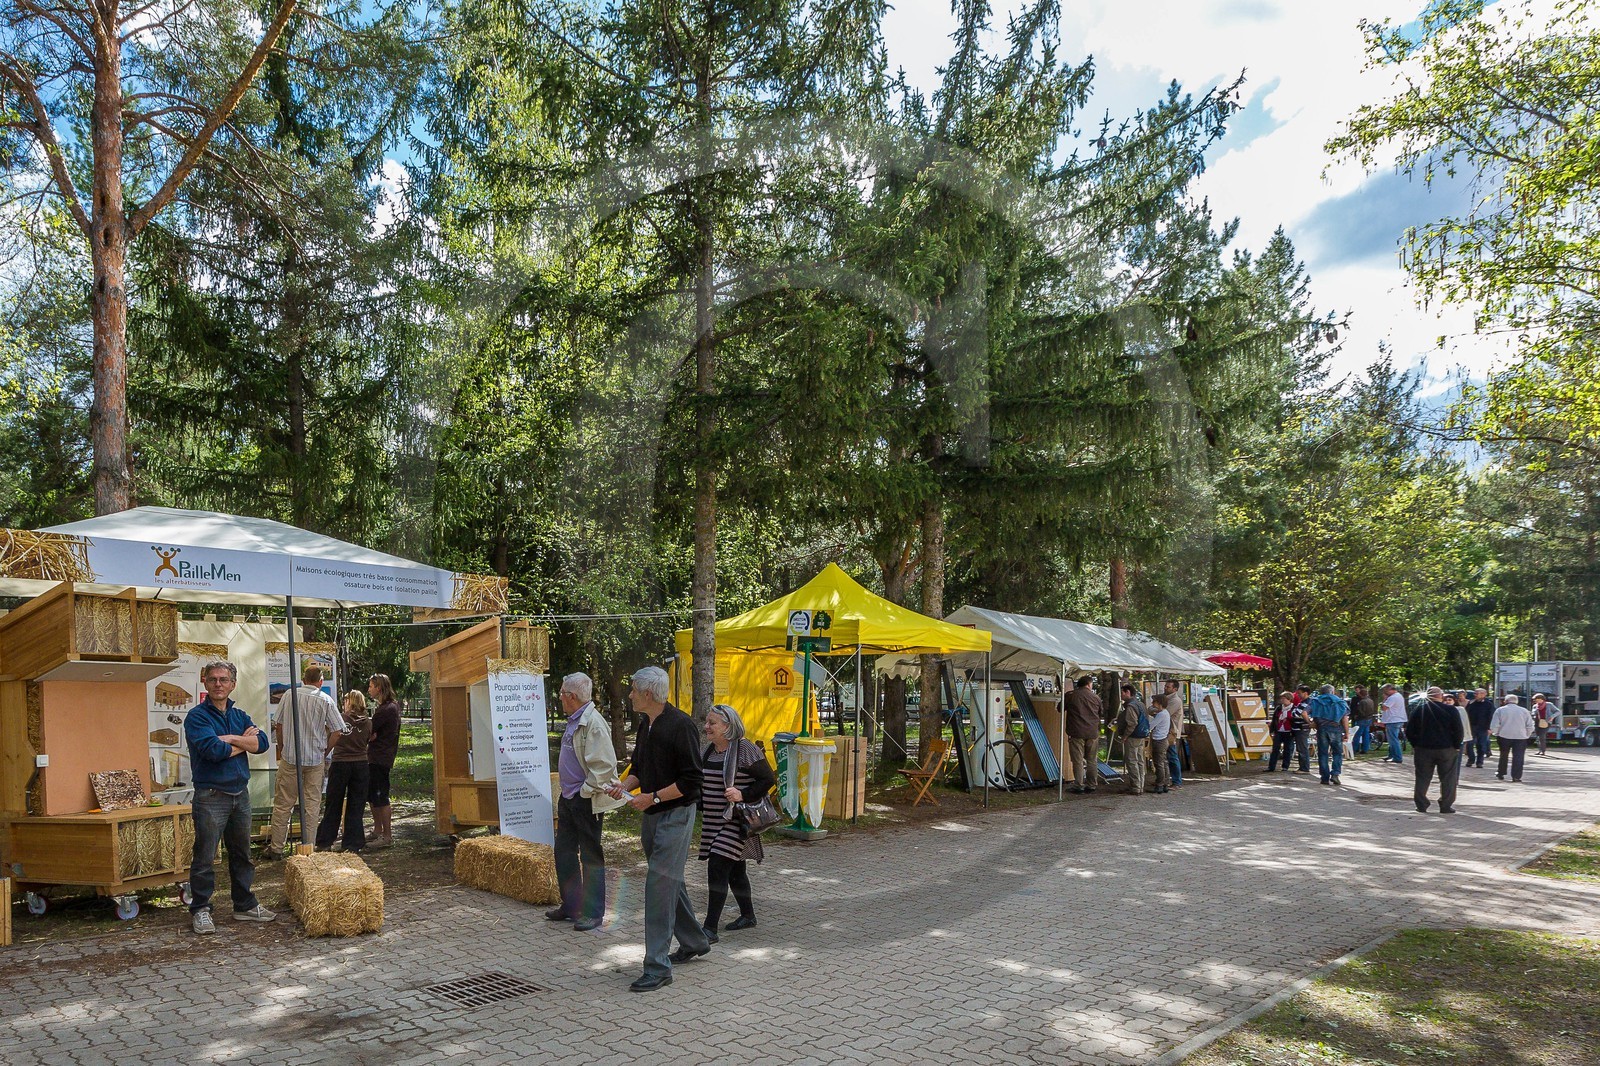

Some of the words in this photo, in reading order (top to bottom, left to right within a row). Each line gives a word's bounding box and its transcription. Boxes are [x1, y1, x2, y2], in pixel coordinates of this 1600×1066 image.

[178, 560, 241, 582] PailleMen
[296, 566, 322, 574] Maisons
[324, 568, 362, 579] écologiques
[395, 577, 438, 586] consommation
[395, 586, 420, 594] isolation
[494, 683, 520, 692] Pourquoi
[522, 683, 538, 691] isoler
[504, 694, 521, 703] paille
